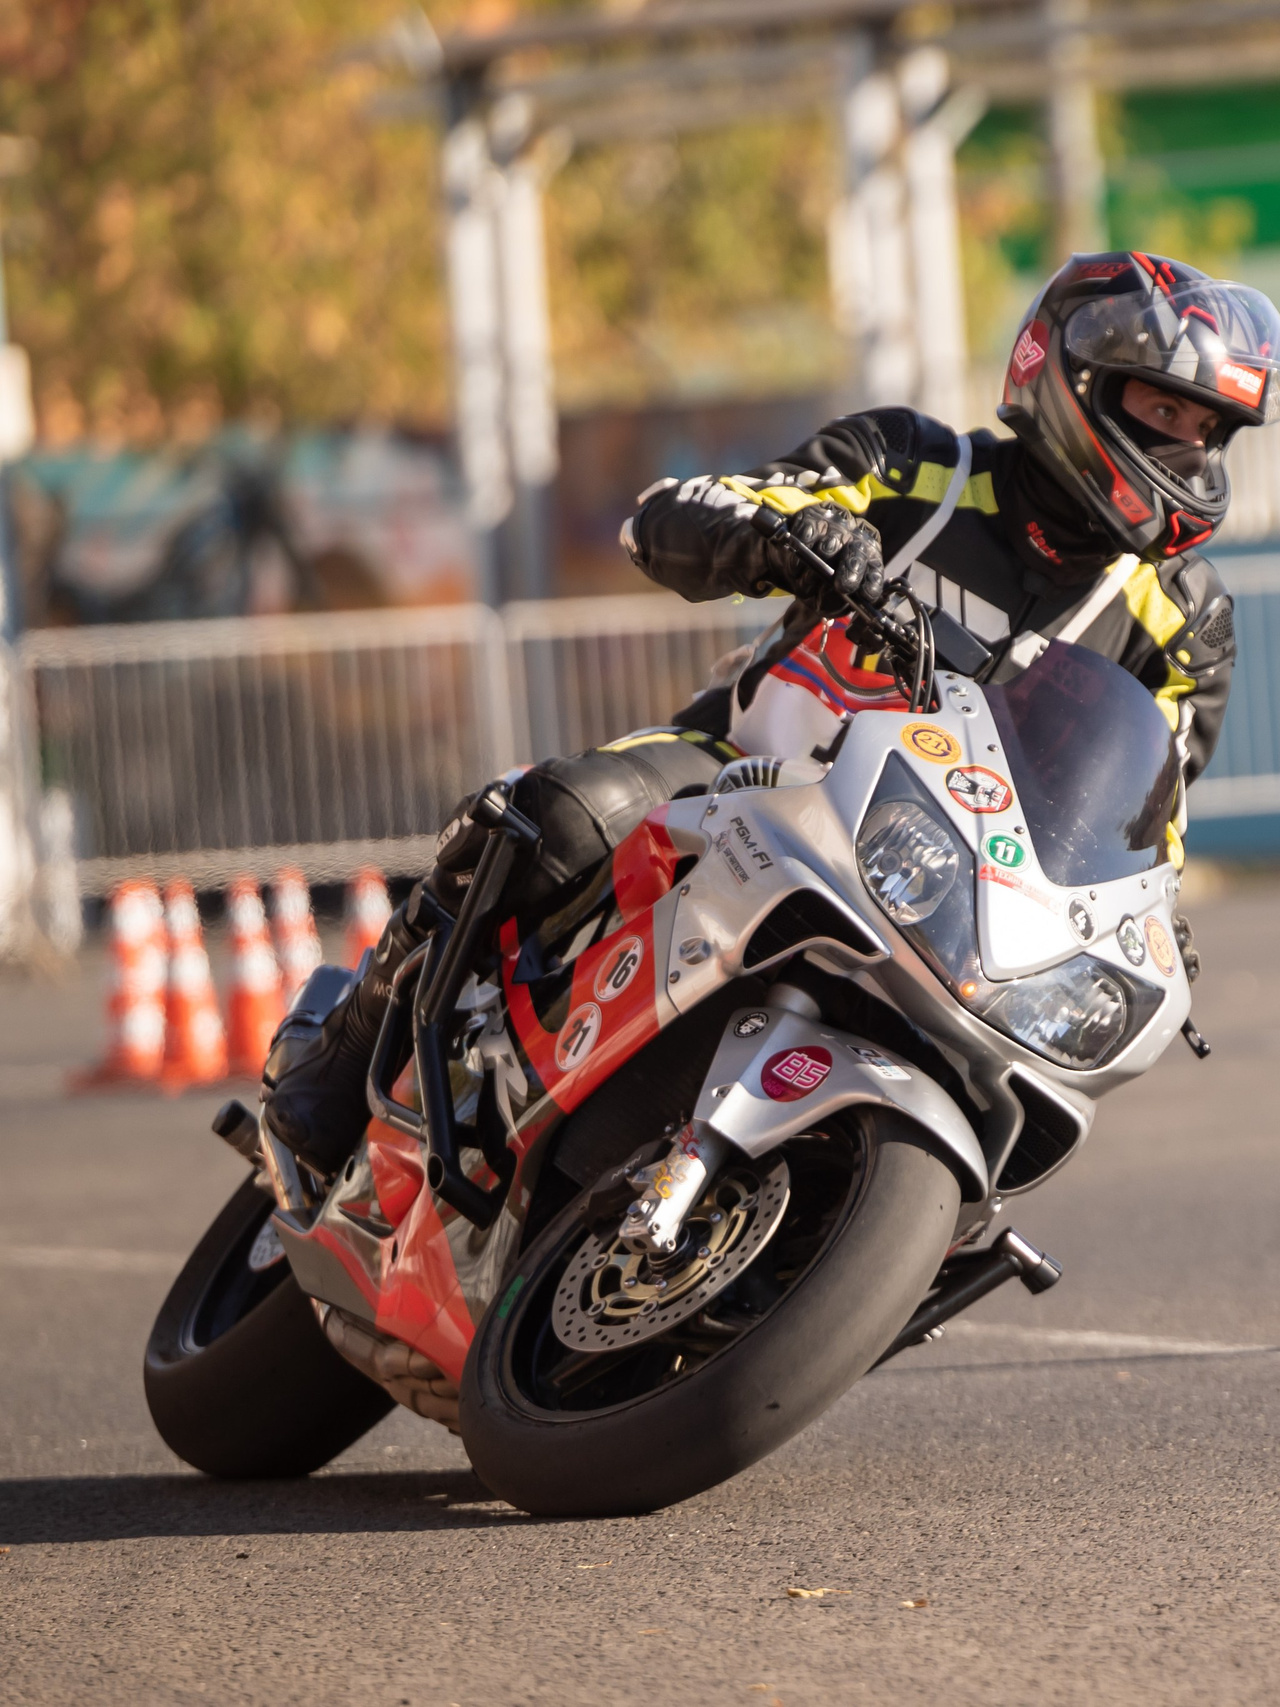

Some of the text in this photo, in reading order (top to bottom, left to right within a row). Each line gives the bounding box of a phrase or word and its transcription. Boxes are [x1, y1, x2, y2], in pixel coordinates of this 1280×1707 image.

[1219, 363, 1263, 392] NOLAN
[918, 733, 943, 751] 21
[995, 841, 1017, 864] 11
[605, 949, 639, 989] 16
[561, 1018, 593, 1057] 21
[772, 1051, 831, 1089] 85
